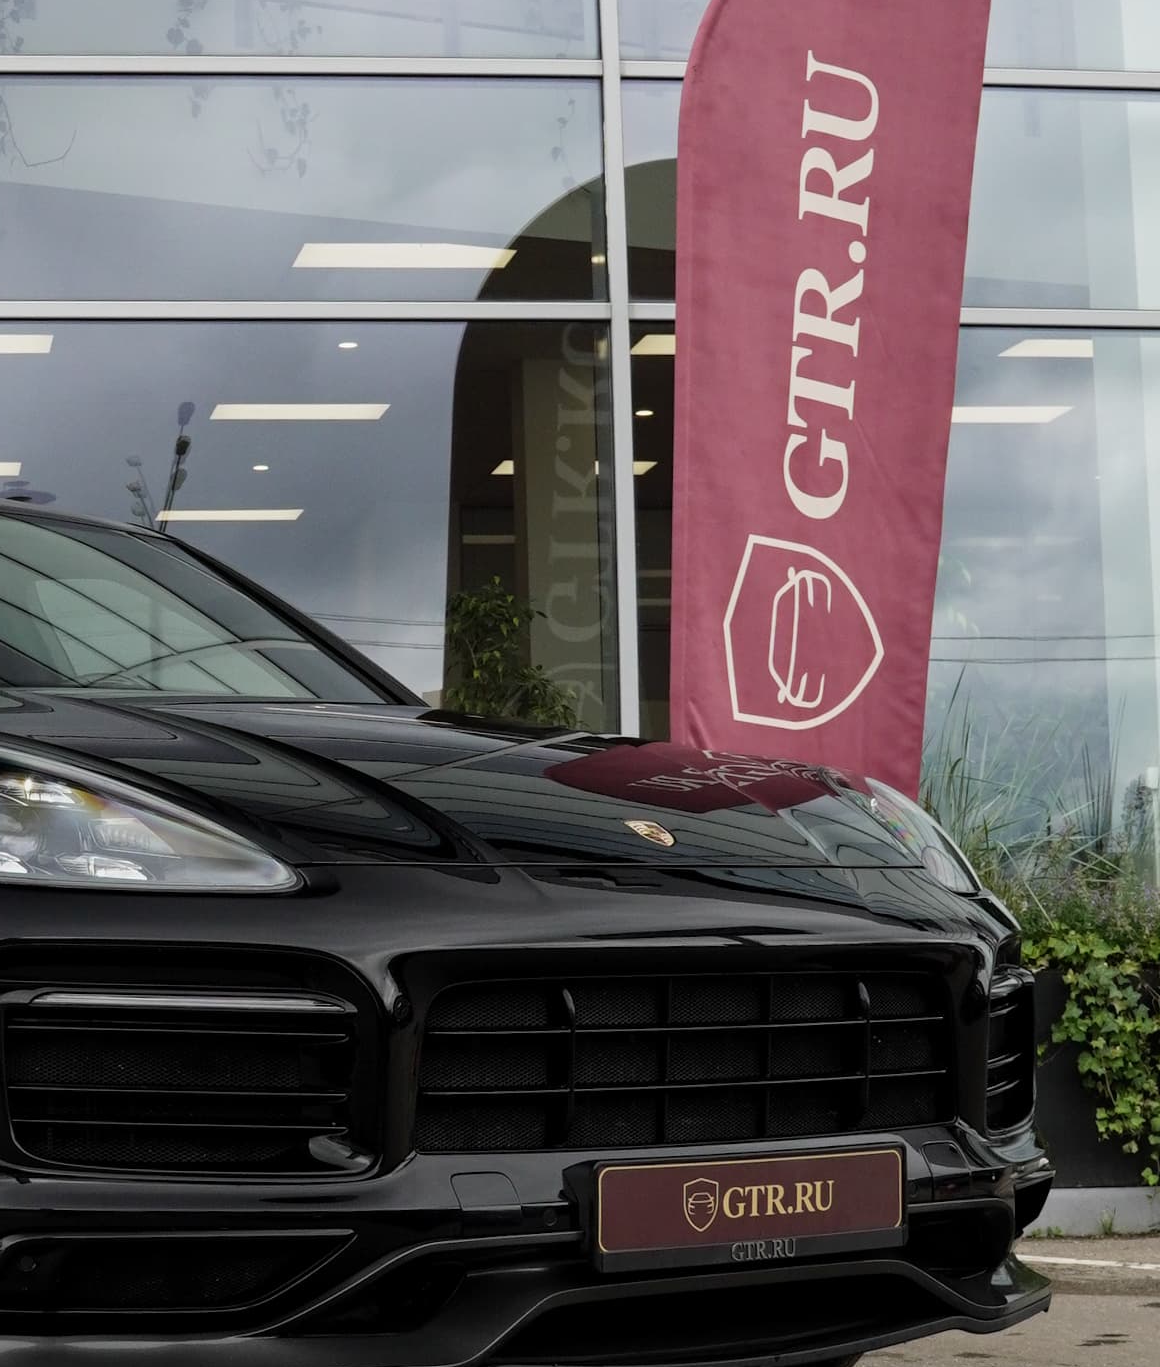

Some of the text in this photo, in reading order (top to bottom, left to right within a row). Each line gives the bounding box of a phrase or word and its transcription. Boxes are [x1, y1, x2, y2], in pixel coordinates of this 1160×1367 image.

[783, 49, 881, 521] GTR.RU
[722, 1179, 835, 1219] GTR.RU
[730, 1238, 797, 1262] GTR.RU
